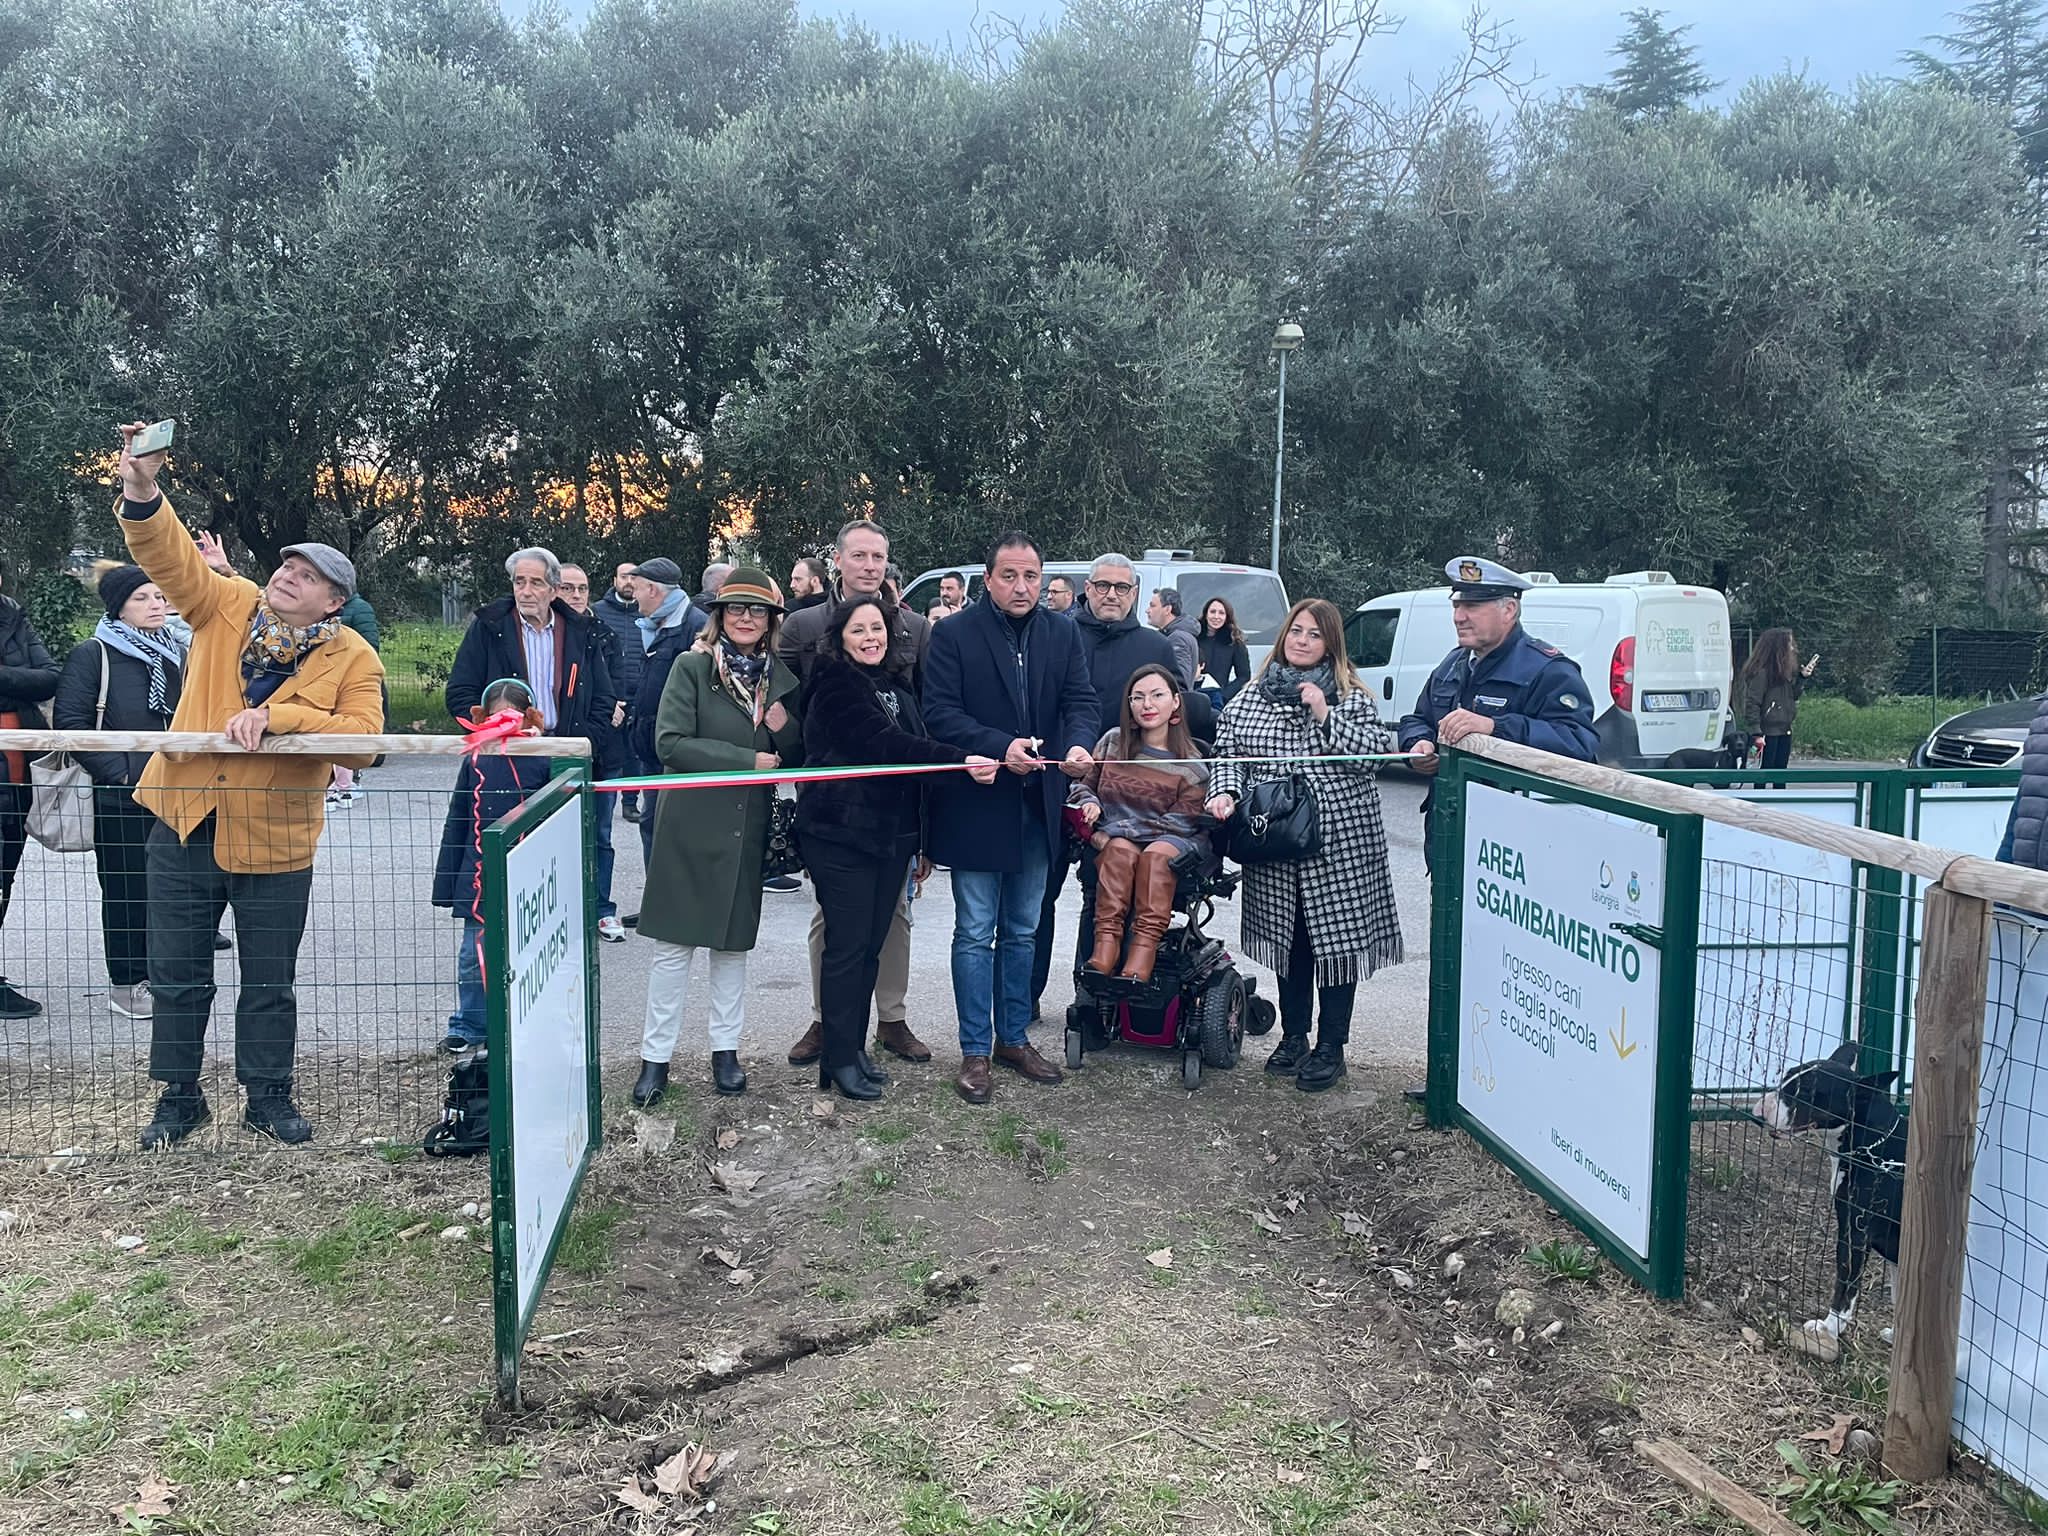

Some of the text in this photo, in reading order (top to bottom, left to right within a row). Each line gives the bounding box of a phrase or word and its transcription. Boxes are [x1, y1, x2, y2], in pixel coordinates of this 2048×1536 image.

[1477, 838, 1526, 886] AREA
[516, 855, 558, 955] liberi di
[1476, 877, 1640, 983] SGAMBAMENTO
[518, 903, 569, 1025] muoversi
[1502, 943, 1582, 1010] Ingresso cani
[1500, 1009, 1556, 1059] e cuccioli
[1501, 976, 1598, 1053] di taglia piccola
[1551, 1127, 1631, 1203] liberi di muoversi
